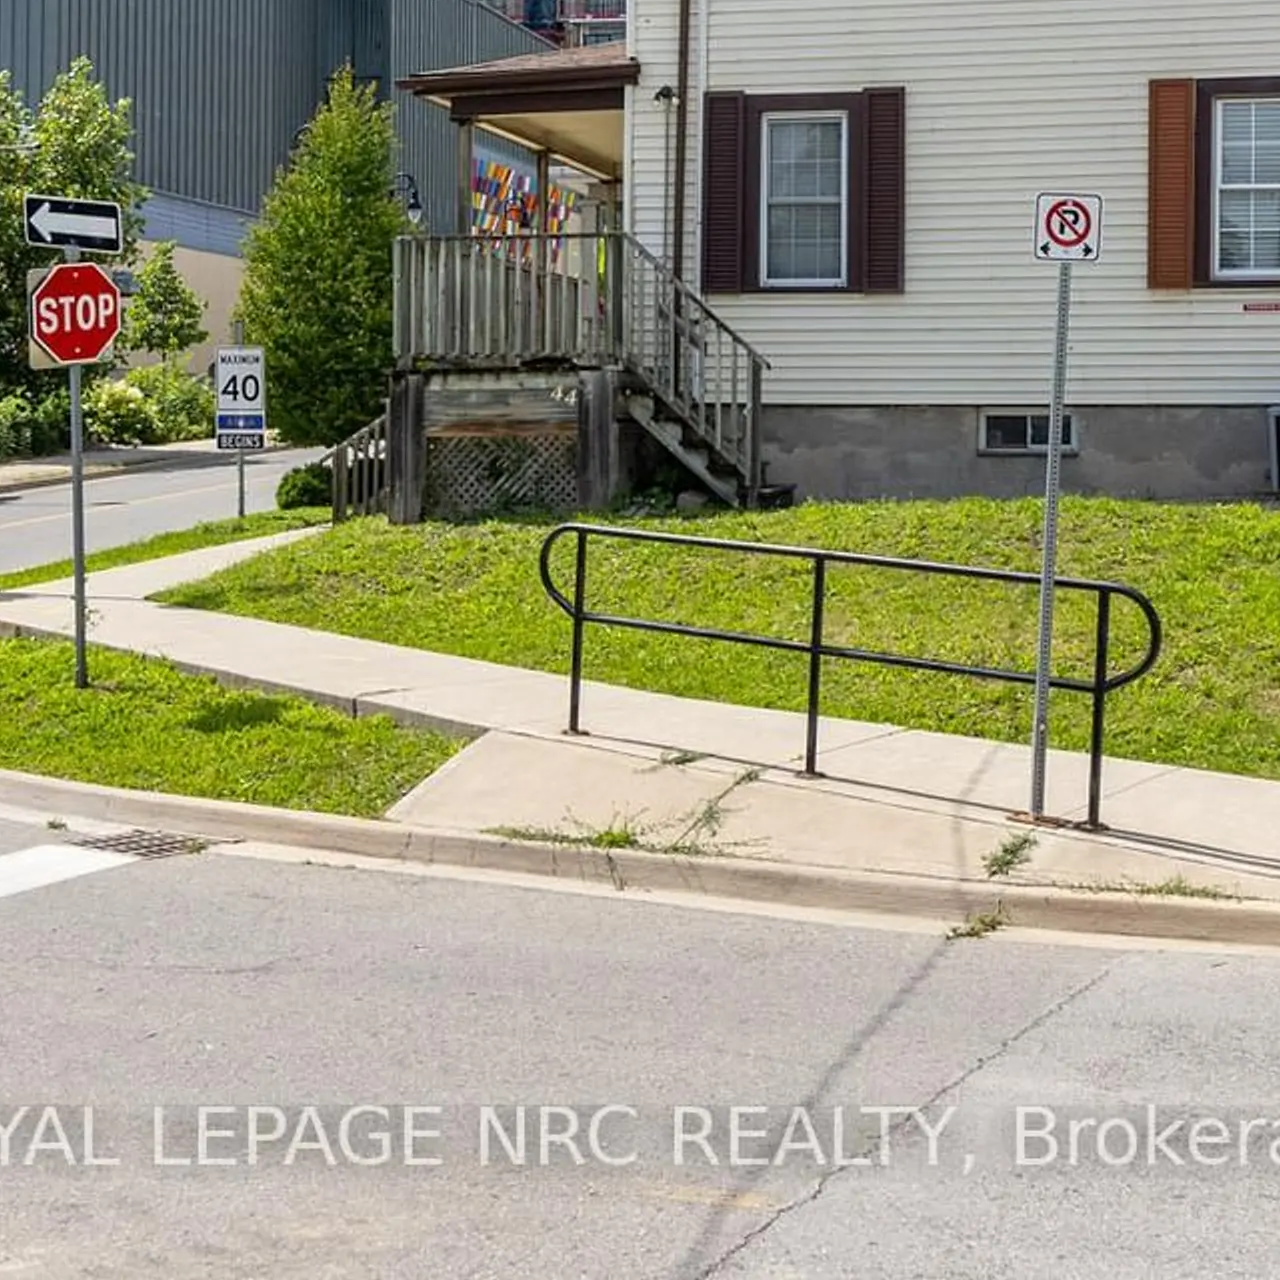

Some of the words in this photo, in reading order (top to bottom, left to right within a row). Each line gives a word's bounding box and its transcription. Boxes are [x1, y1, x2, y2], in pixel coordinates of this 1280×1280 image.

[39, 294, 115, 334] STOP
[220, 355, 260, 365] MAXIMUM
[221, 374, 260, 402] 40
[550, 385, 577, 406] 44
[220, 435, 261, 448] BEGINS
